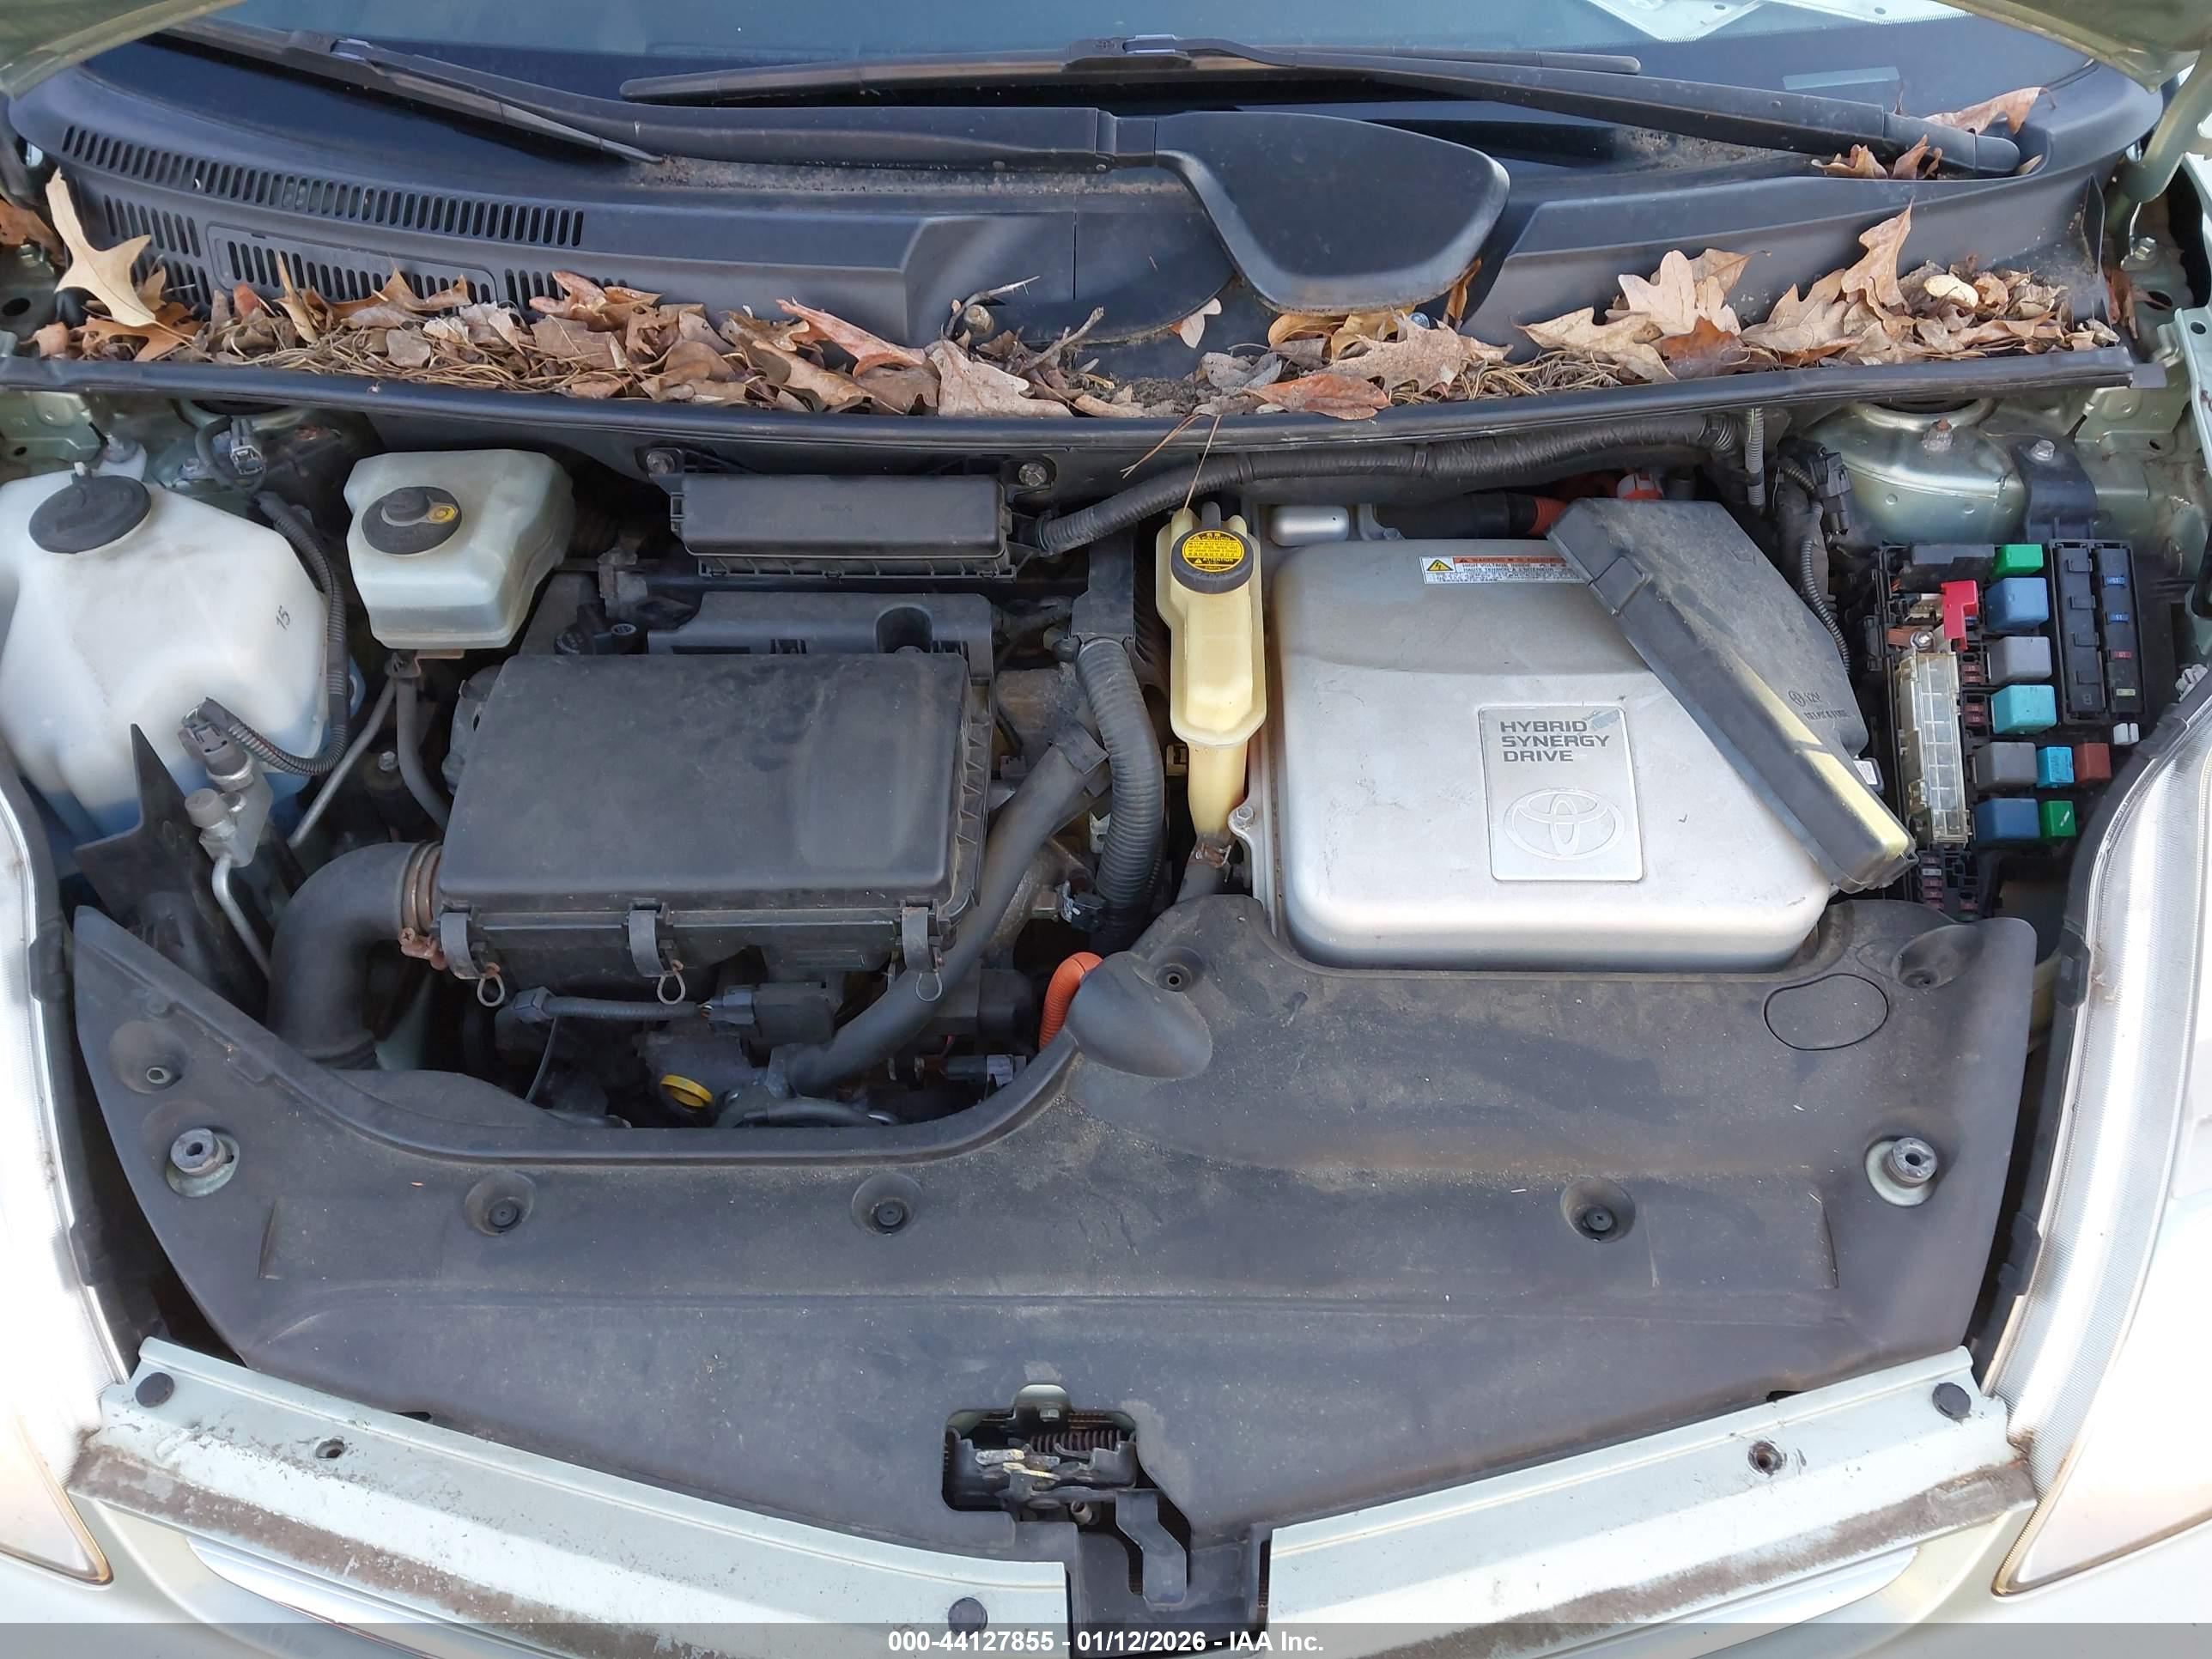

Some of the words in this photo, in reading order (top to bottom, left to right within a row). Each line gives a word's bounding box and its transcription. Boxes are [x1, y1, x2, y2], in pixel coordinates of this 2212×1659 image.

[276, 605, 290, 630] 15
[1500, 720, 1588, 732] HYBRID
[1502, 735, 1610, 747] SYNERGY
[1504, 750, 1573, 762] DRIVE
